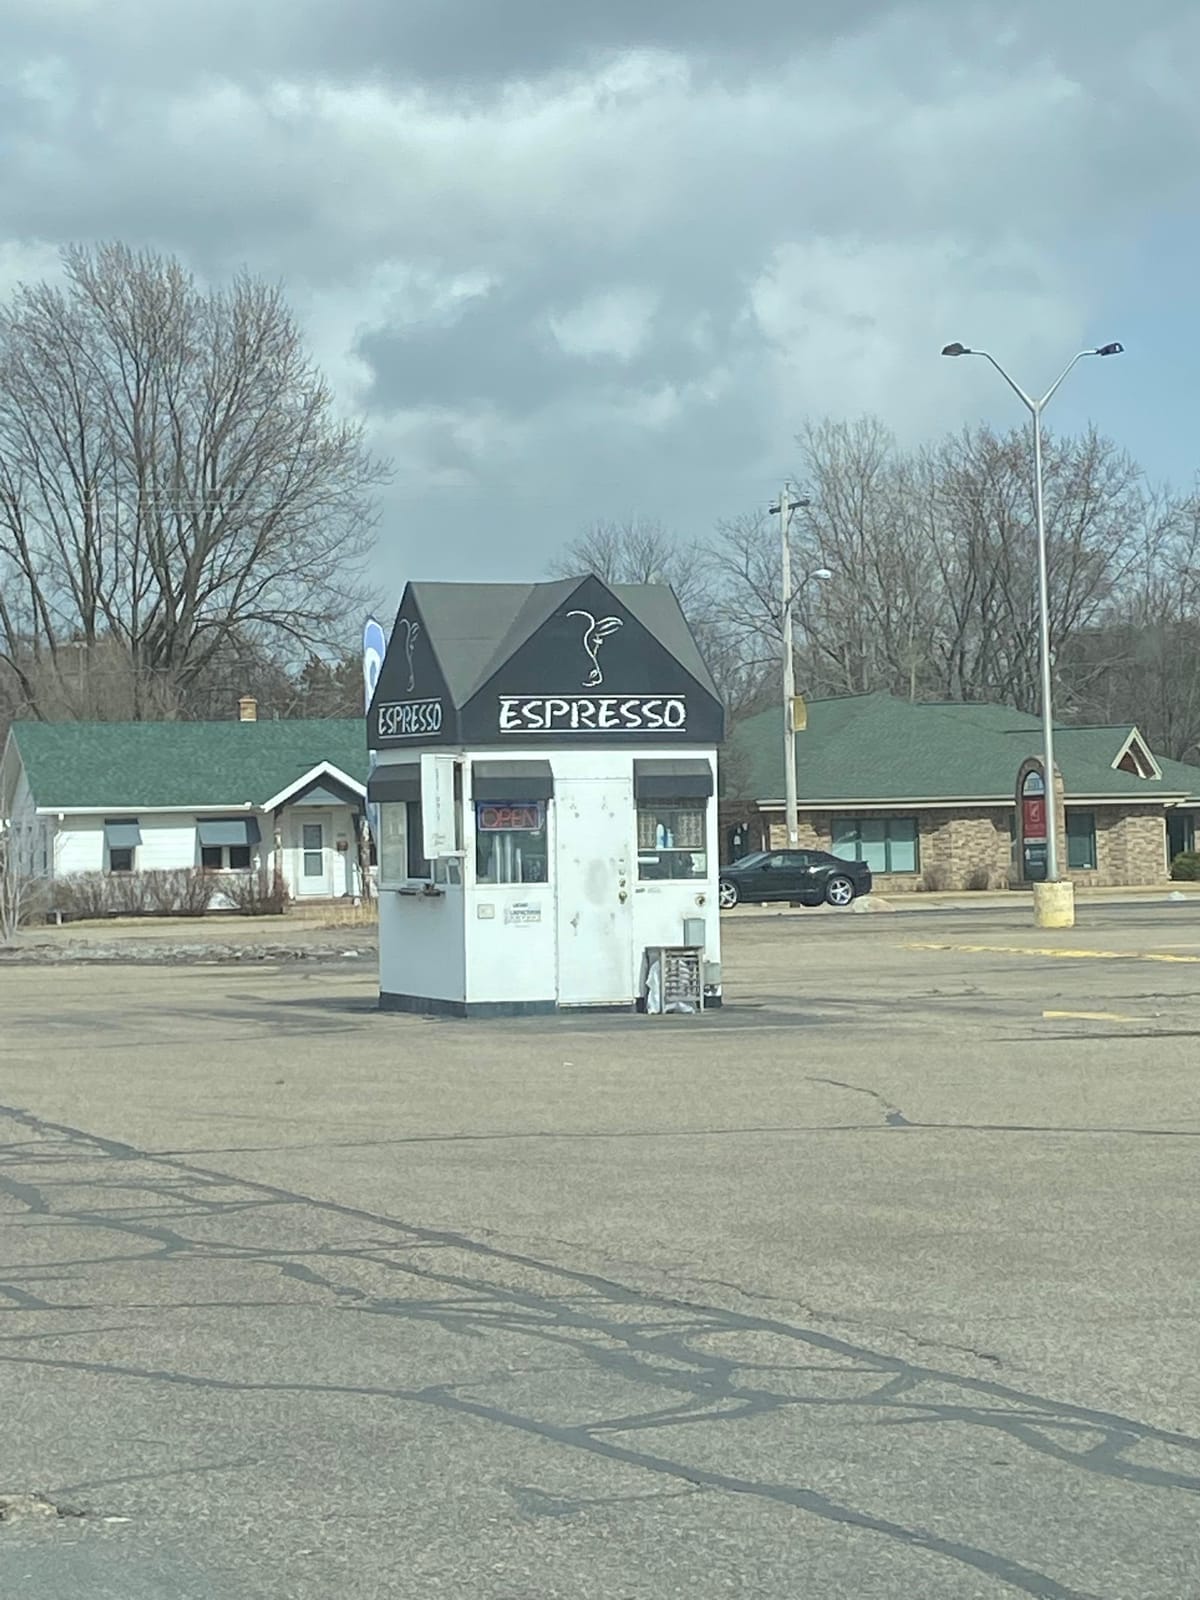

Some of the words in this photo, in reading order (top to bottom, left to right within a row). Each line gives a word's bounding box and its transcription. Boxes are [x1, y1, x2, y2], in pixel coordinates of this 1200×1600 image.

[378, 703, 442, 735] ESPRESSO
[499, 699, 687, 729] ESPRESSO
[481, 808, 536, 829] OPEN
